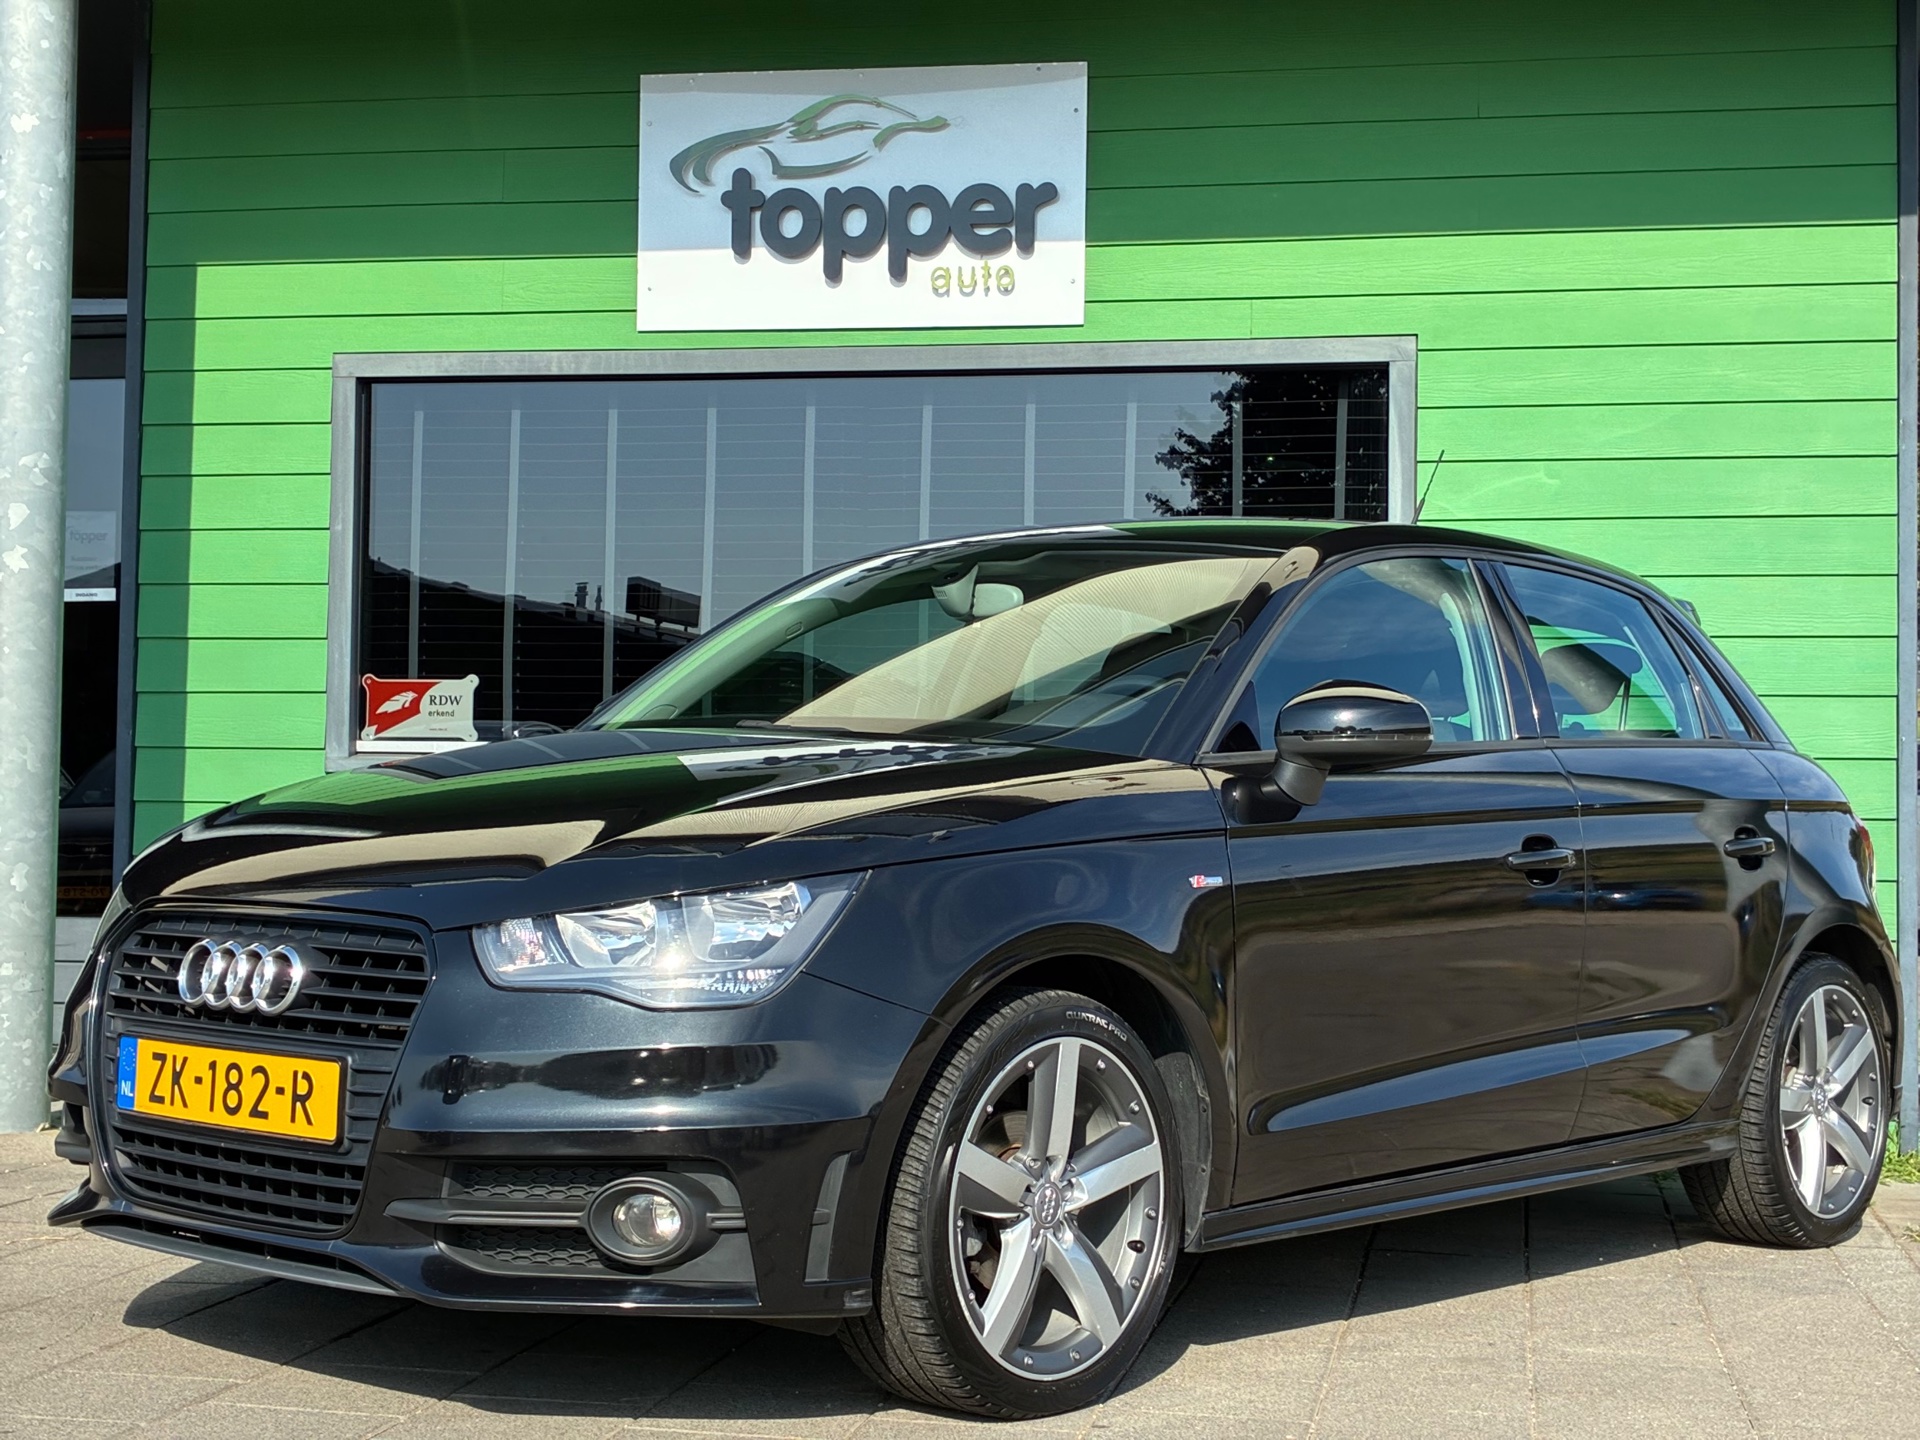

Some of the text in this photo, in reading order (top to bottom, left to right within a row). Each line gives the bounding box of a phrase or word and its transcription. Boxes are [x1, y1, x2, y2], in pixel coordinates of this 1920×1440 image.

[720, 167, 1058, 283] topper
[931, 260, 1015, 293] auto
[69, 529, 109, 544] topper
[428, 695, 463, 706] RDW
[428, 709, 455, 717] erkend
[1065, 1010, 1128, 1042] QUATRAC PRO
[121, 1080, 134, 1097] NL
[148, 1051, 314, 1126] ZK-182-R
